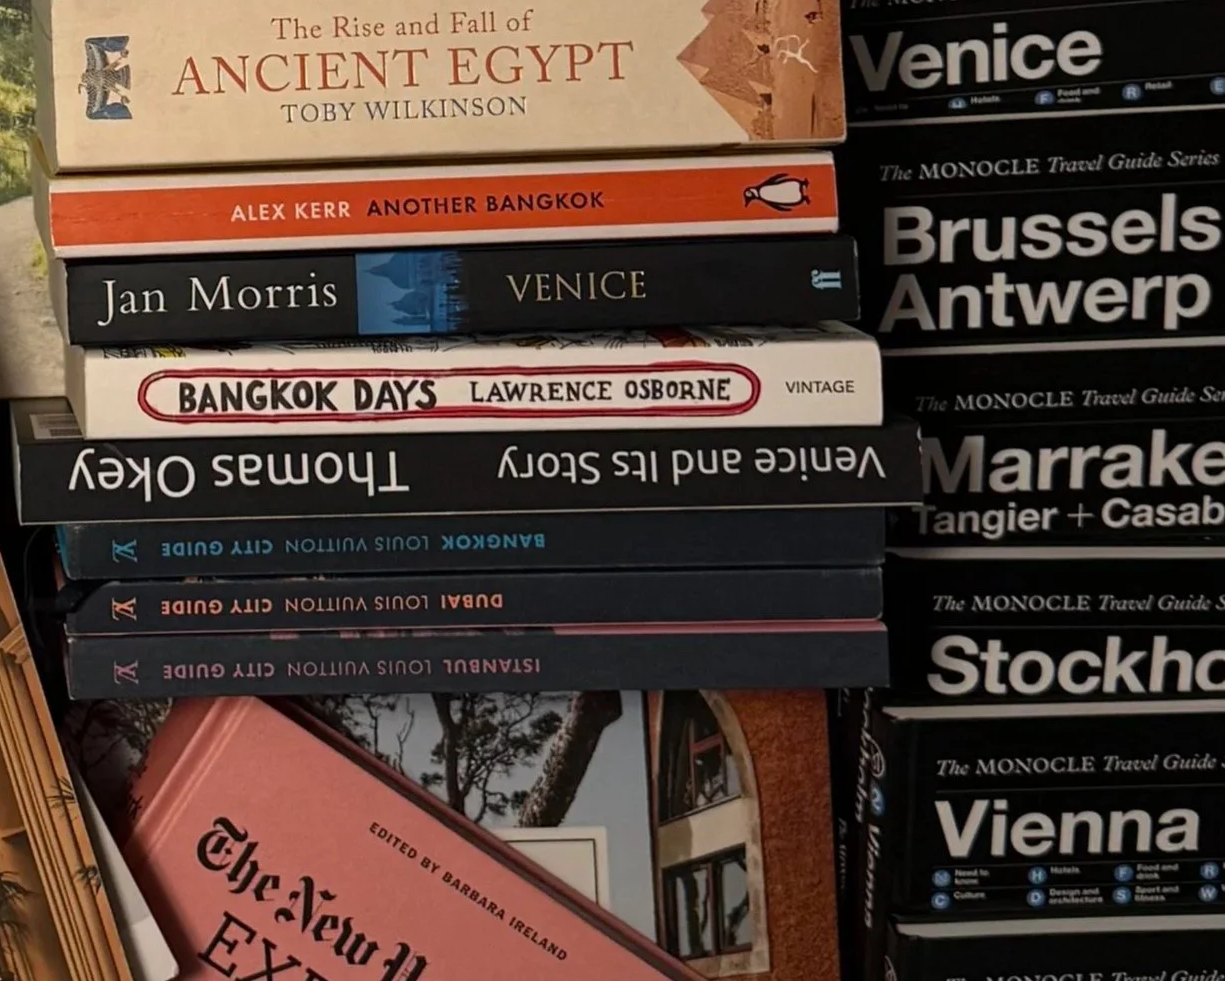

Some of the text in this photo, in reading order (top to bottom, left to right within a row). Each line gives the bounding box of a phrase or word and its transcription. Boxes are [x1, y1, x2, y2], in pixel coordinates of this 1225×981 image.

[271, 8, 534, 40] The Rise and Fall of
[170, 40, 634, 97] ANCIENT EGYPT
[848, 22, 1104, 92] Venice
[280, 95, 528, 124] TOBY WILKINSON
[879, 149, 1221, 181] The MONOCLE Travel Guide Series
[230, 190, 606, 222] ALEX KERR ANOTHER BANGKOK
[882, 192, 1222, 267] Brussels
[97, 278, 168, 327] Jan
[187, 271, 338, 313] Morris
[505, 270, 648, 304] VENICE
[878, 271, 1213, 333] Antwerp
[178, 377, 855, 414] BANGKOK DAYS LAWRENCE OSBORNE VINTAGE
[68, 448, 410, 503] Thomas Okey
[497, 445, 887, 486] Venice and Its Story
[921, 428, 1225, 494] Marrake
[162, 533, 545, 557] BANGKOK LOUIS VUITTON CITY GUIDE
[911, 501, 1058, 541] Tangier
[161, 593, 503, 615] DUBAI LOUIS VUITTON CITY GUIDE
[163, 657, 540, 680] ISTANBUL LOUIS VUITTON CITY GUIDE
[927, 634, 1225, 697] Stockho
[934, 798, 1200, 858] Vienna
[196, 816, 380, 966] The New
[368, 822, 569, 962] EDITED BY BARBARA IRELAND
